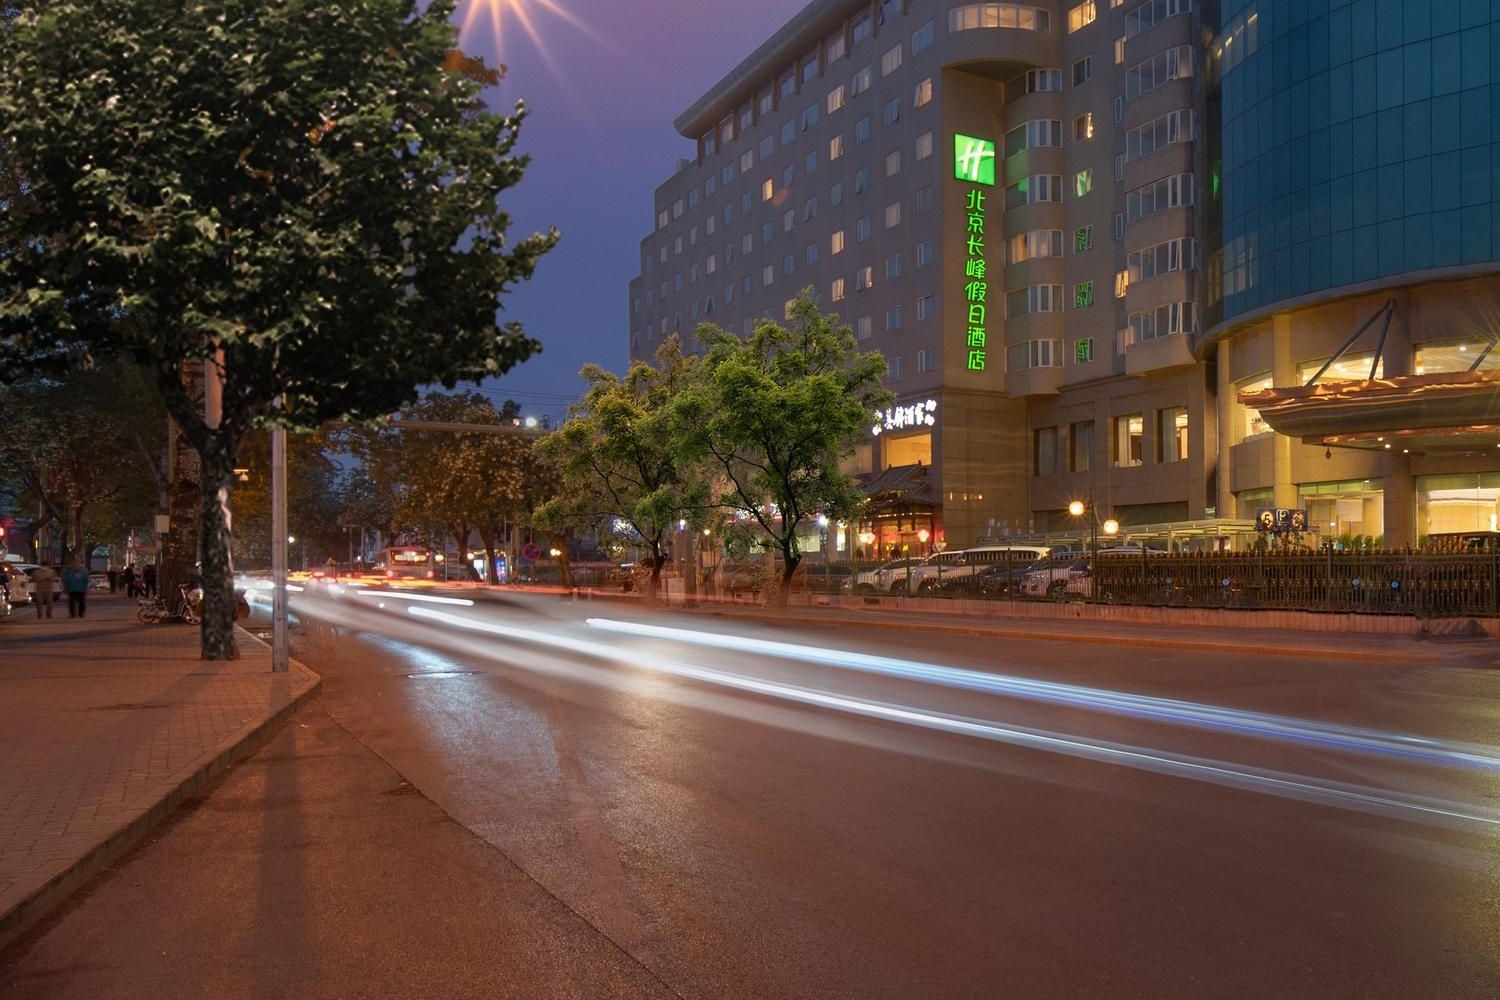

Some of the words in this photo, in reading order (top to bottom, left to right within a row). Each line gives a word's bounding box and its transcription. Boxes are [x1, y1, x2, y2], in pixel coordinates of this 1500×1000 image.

[965, 189, 987, 371] 北京长峰假日酒店
